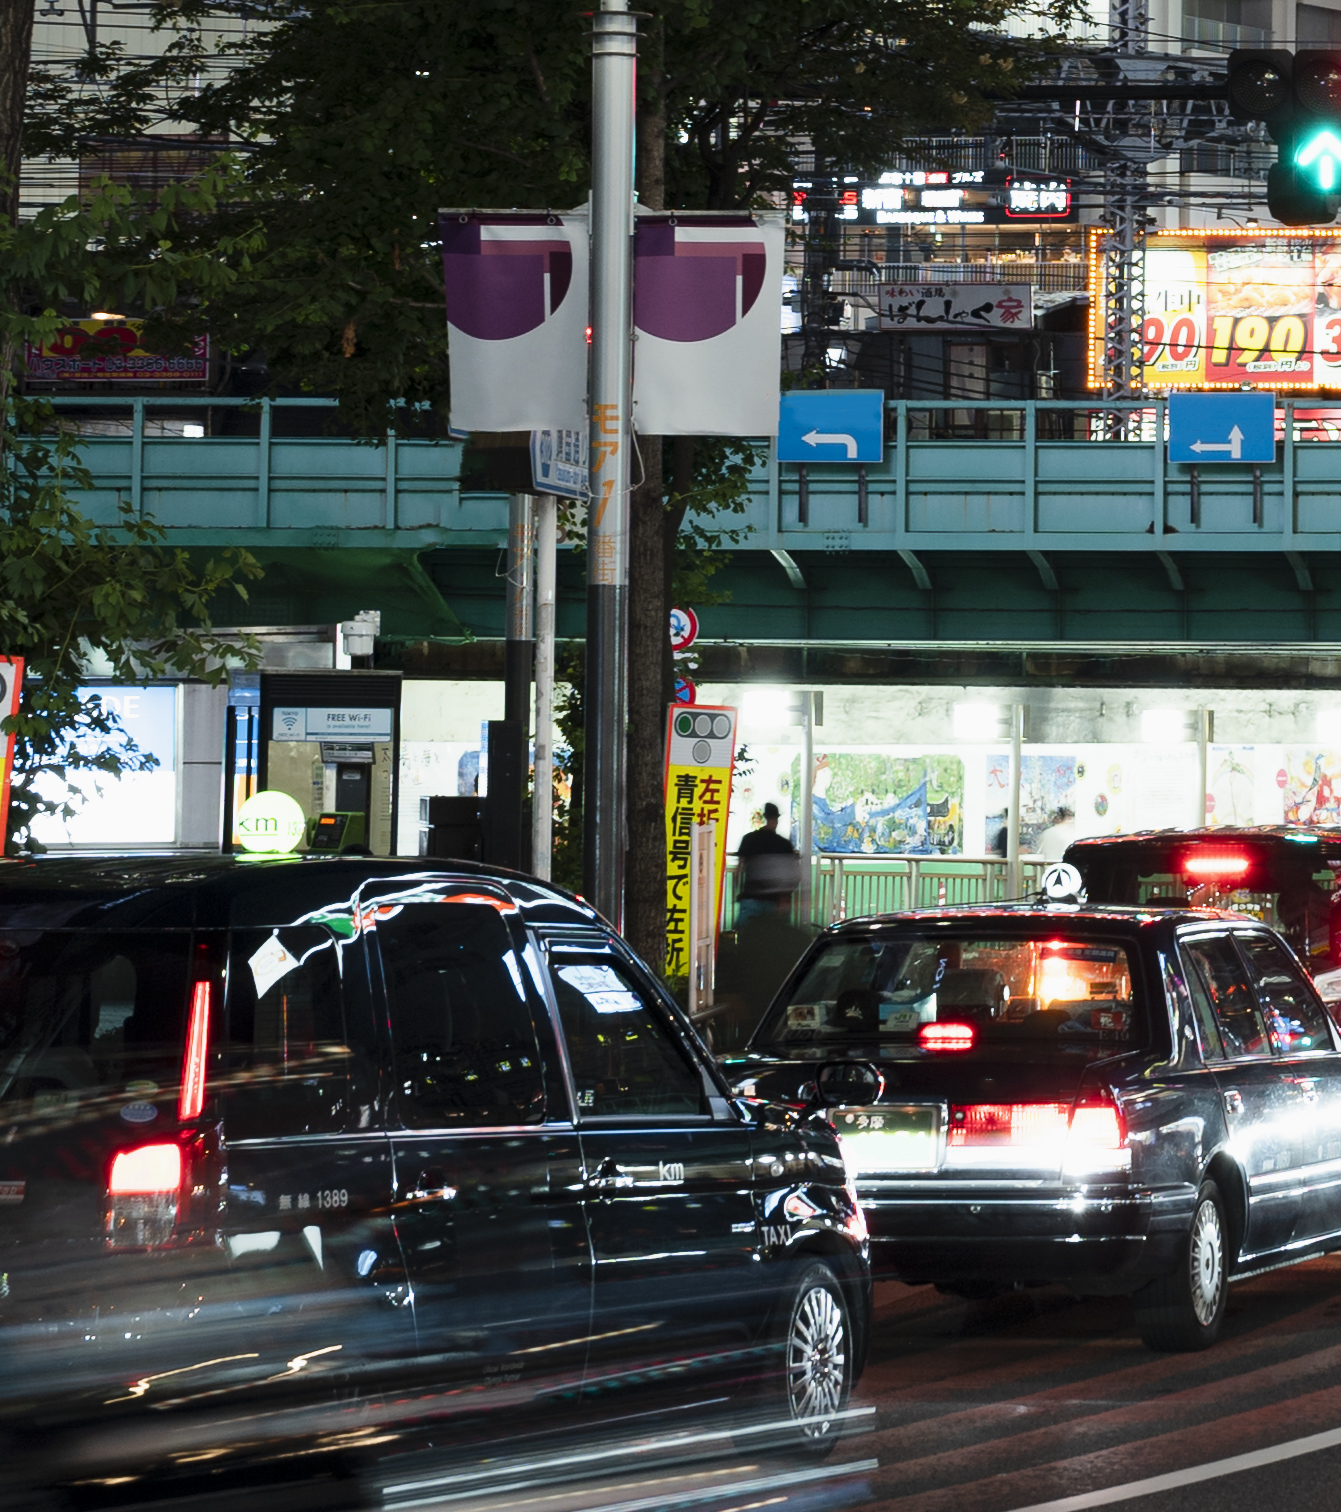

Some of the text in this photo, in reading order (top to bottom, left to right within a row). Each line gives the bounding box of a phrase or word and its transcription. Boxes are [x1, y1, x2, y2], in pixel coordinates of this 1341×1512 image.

[1209, 316, 1306, 364] 190
[326, 713, 372, 722] FREE Wi-Fi
[238, 817, 278, 832] km
[665, 773, 699, 967] 青信号で左折
[855, 1114, 886, 1131] 多摩
[658, 1160, 685, 1180] km
[278, 1188, 349, 1211] 無線 1389
[761, 1224, 792, 1247] TAXI
